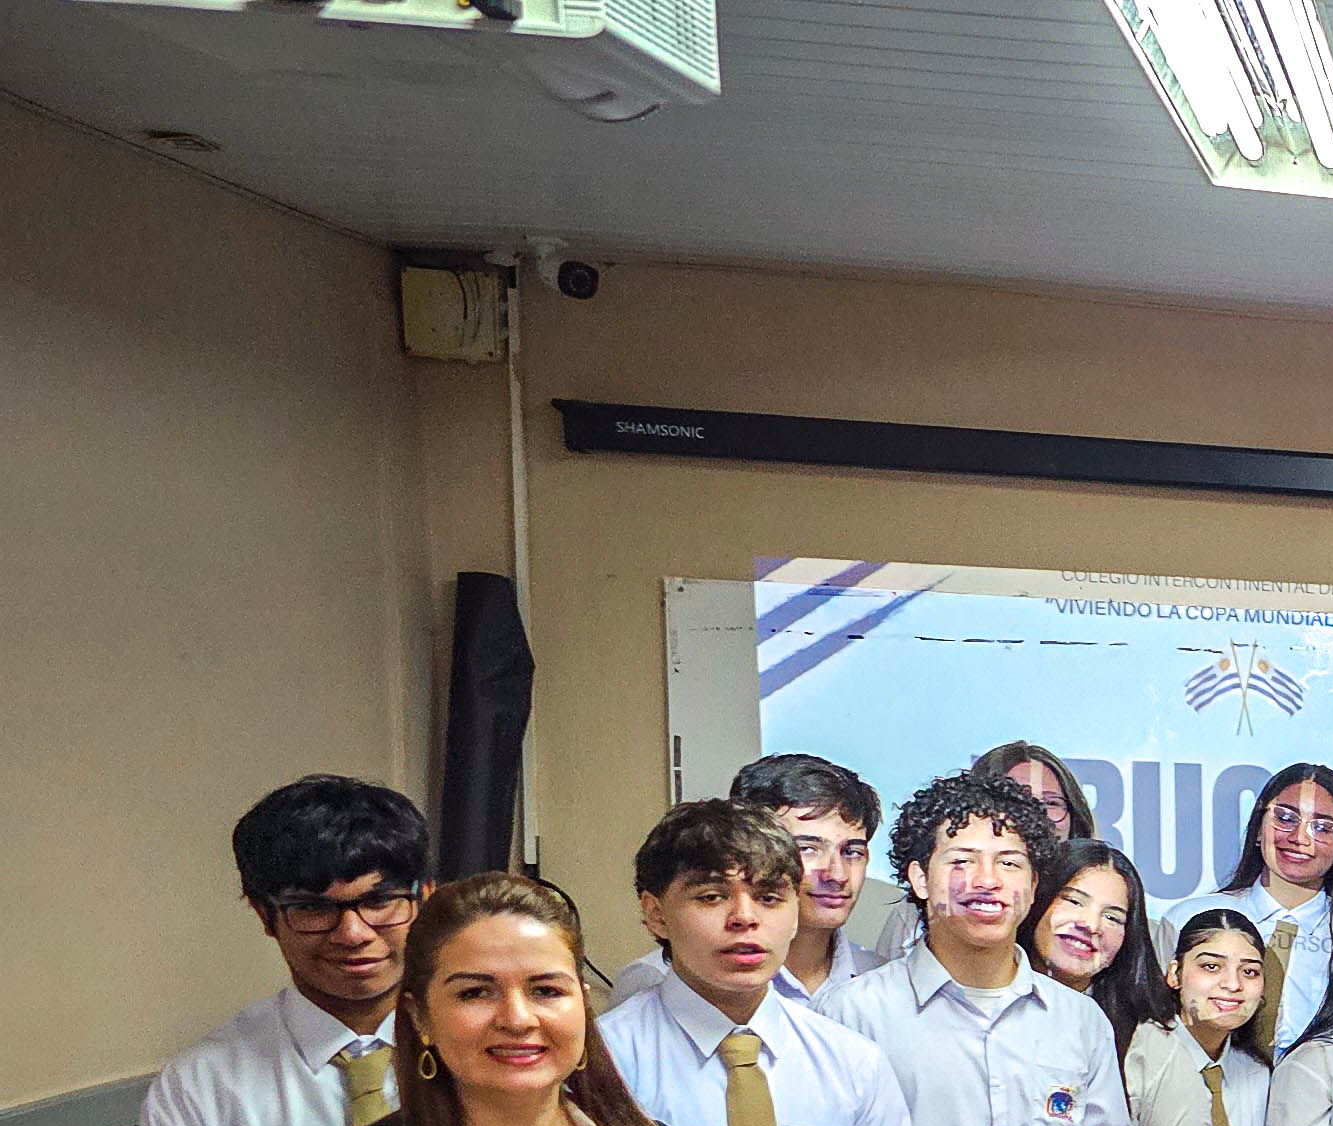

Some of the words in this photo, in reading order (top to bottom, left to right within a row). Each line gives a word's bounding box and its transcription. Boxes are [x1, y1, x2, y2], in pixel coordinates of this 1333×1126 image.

[615, 421, 705, 439] SHAMSONIC
[1156, 604, 1182, 619] LA
[1186, 605, 1240, 623] COPA
